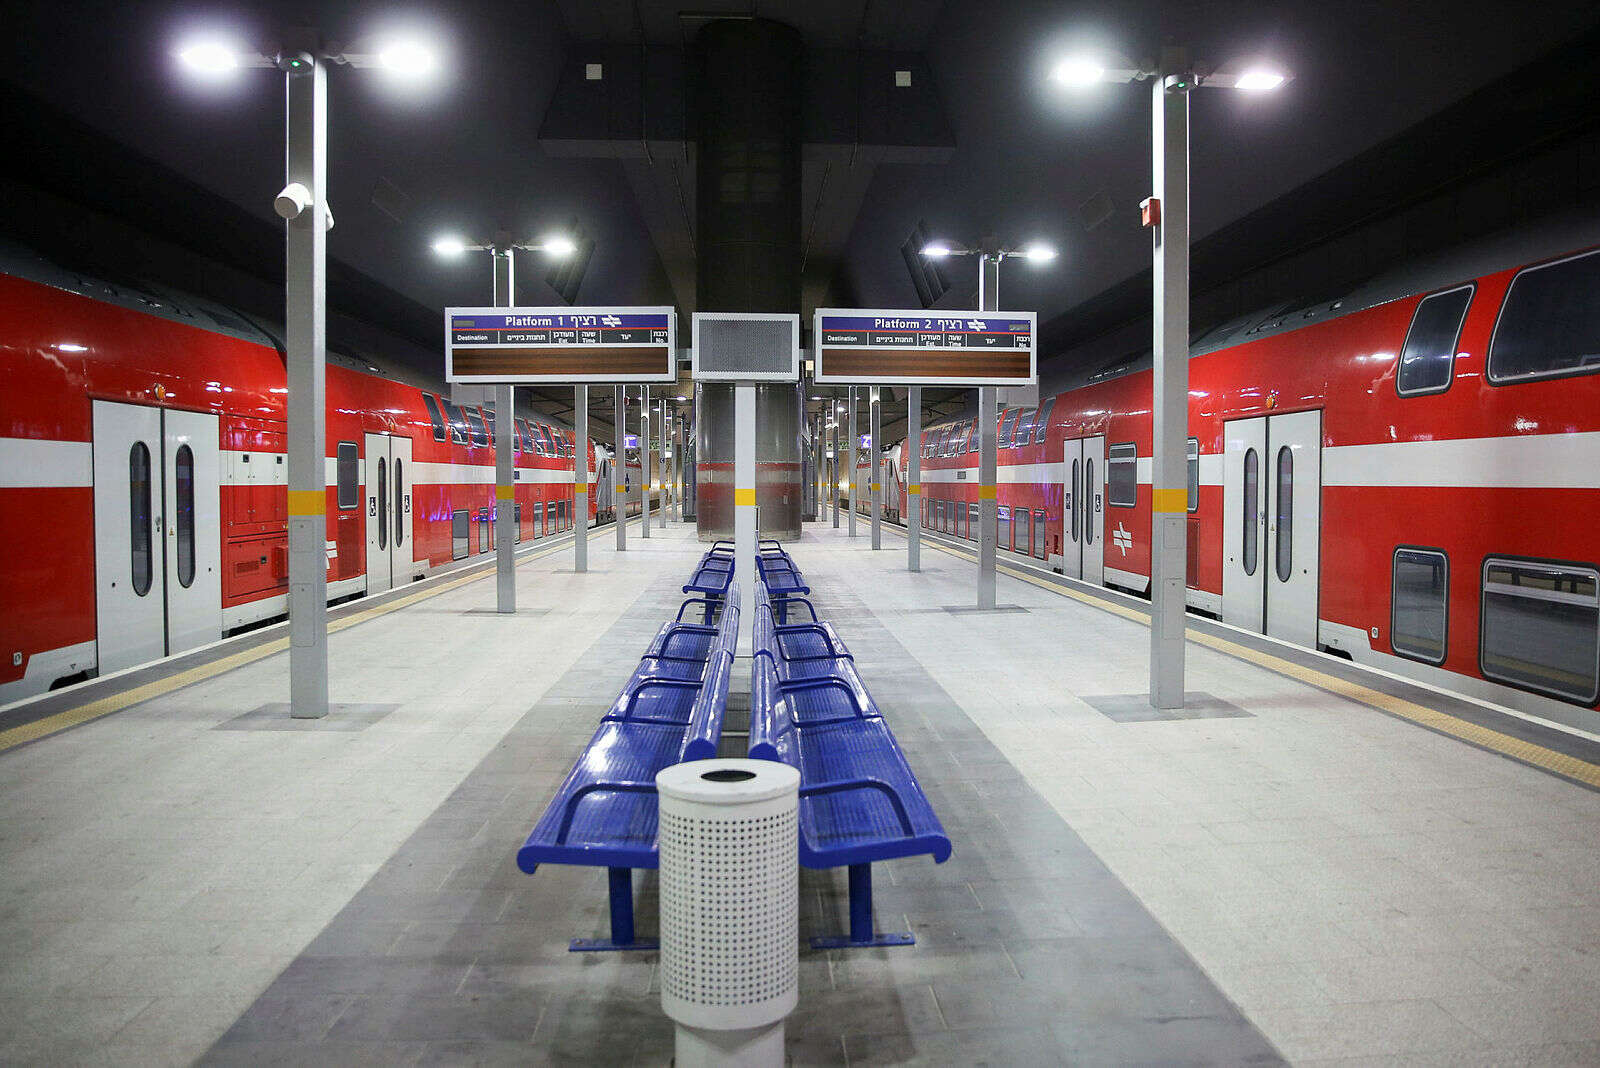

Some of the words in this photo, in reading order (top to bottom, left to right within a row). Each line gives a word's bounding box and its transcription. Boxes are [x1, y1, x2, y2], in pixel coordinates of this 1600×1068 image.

[505, 316, 552, 326] Platform
[558, 316, 563, 326] 1
[570, 315, 597, 328] רציף
[875, 318, 920, 329] Platform
[924, 319, 932, 329] 2
[937, 319, 962, 331] רציף
